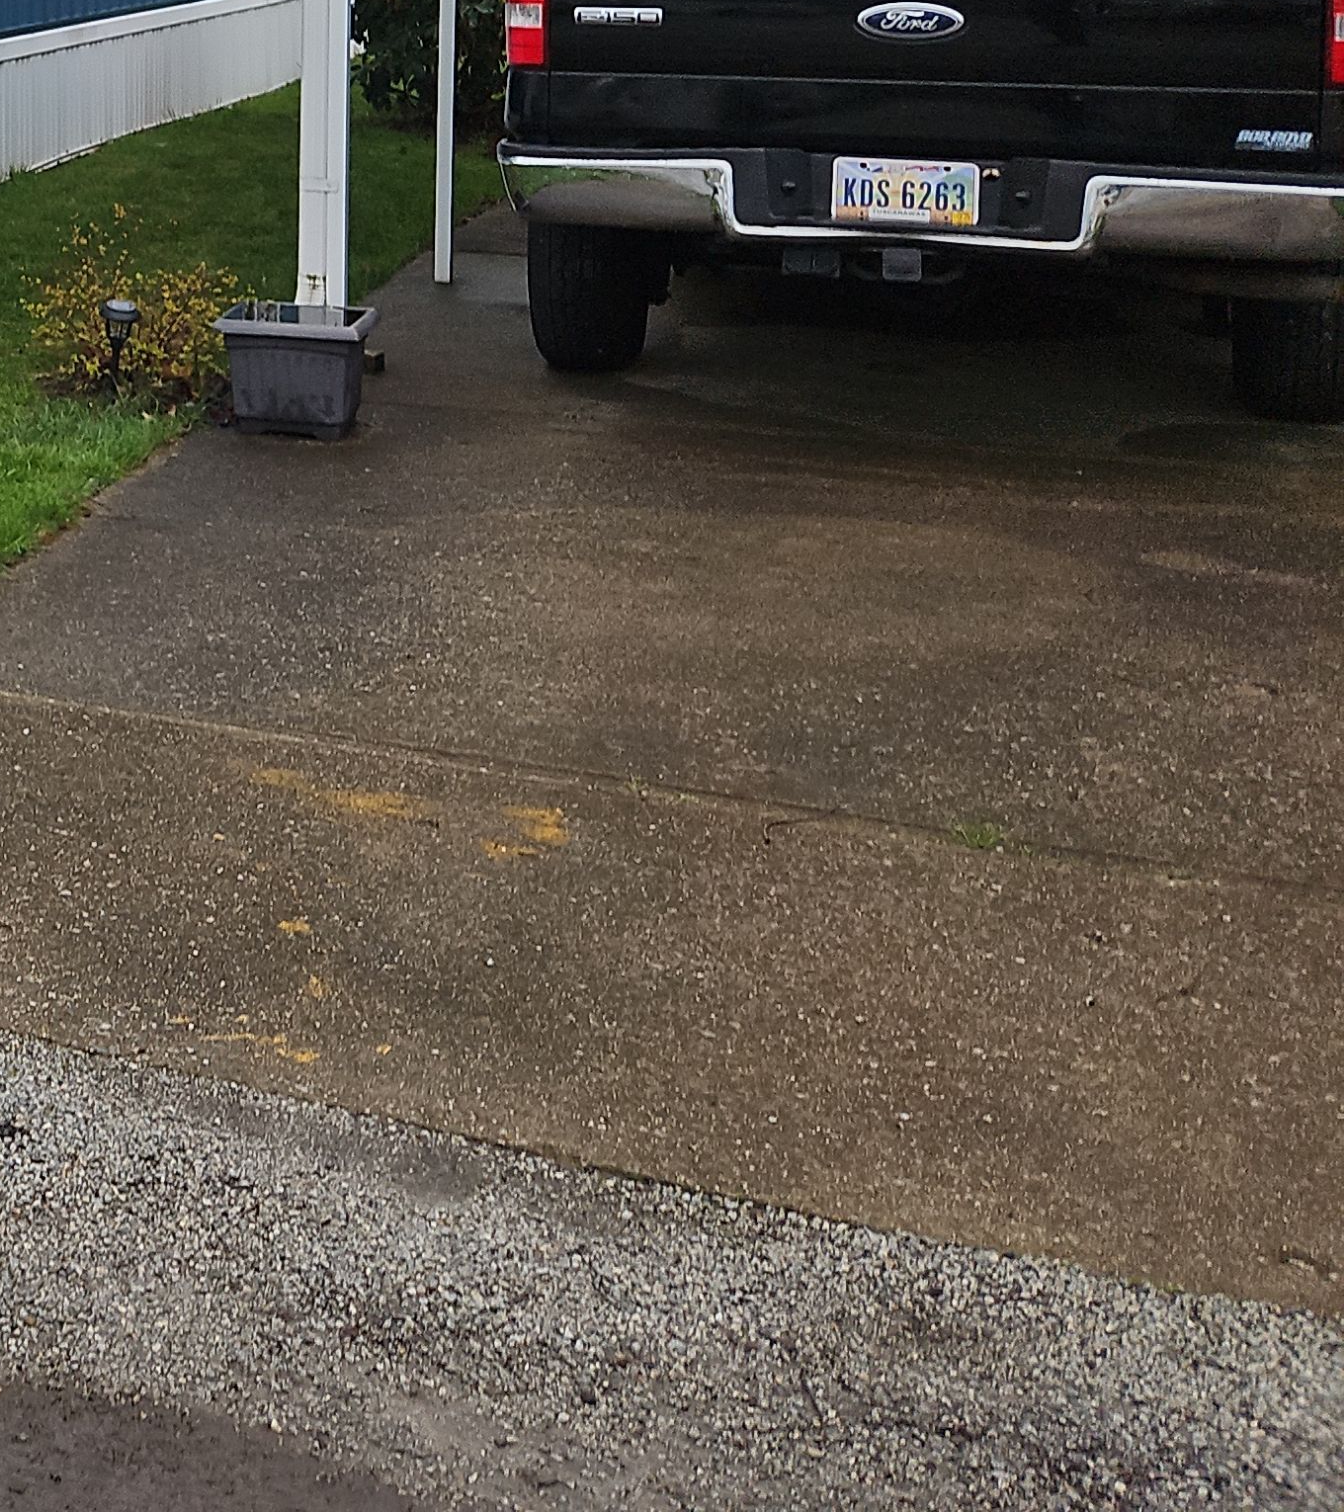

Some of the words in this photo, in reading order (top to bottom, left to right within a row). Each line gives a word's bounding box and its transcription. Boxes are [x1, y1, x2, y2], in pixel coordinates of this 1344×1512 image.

[880, 10, 939, 31] Ford
[843, 177, 890, 208] KDS
[901, 180, 966, 211] 6263
